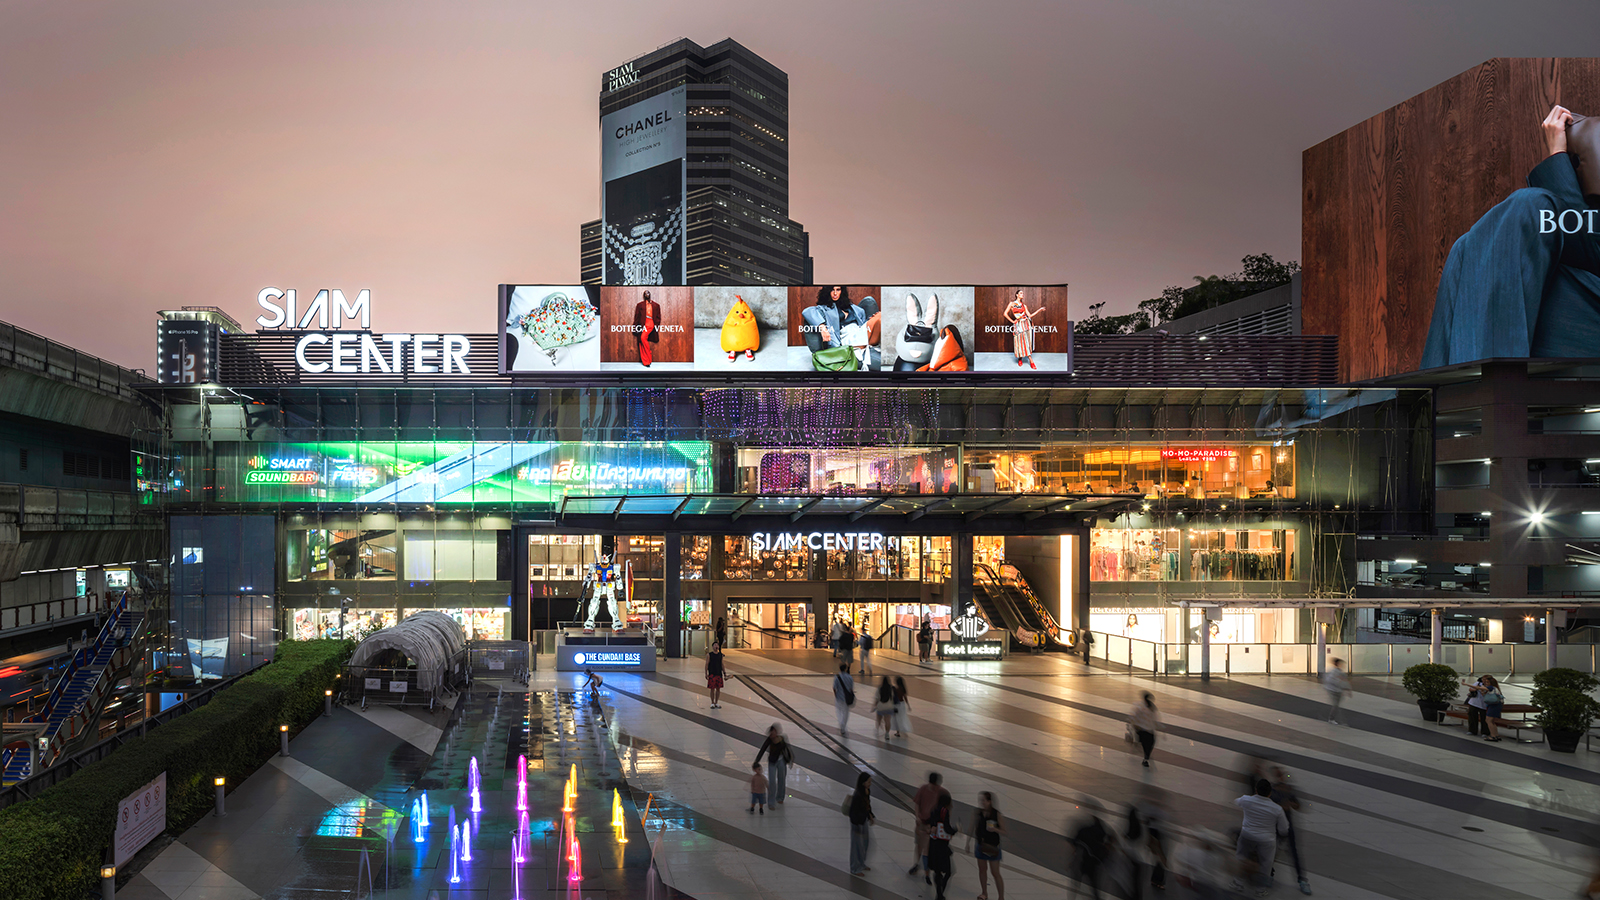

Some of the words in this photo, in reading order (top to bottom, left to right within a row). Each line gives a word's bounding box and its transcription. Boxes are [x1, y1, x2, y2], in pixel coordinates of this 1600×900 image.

[609, 62, 634, 80] SIAM
[609, 69, 640, 92] PIWAT
[615, 109, 672, 140] CHANEL
[619, 137, 635, 148] HIGH
[636, 126, 668, 143] JEWELLERY
[625, 144, 653, 157] COLLECTION
[256, 286, 371, 329] SIAM
[610, 325, 648, 333] BOTTEGA
[654, 325, 684, 333] VENETA
[798, 325, 835, 333] BOTTEGA
[294, 333, 472, 374] CENTER
[270, 458, 313, 469] SMART
[250, 473, 313, 482] SOUNDBAR
[752, 532, 802, 551] SIAM
[807, 532, 883, 551] CENTER
[586, 652, 597, 661] THE
[597, 652, 624, 661] GUNDAM
[624, 652, 641, 661] BASE
[943, 644, 966, 655] Foot
[967, 644, 1001, 655] Locker
